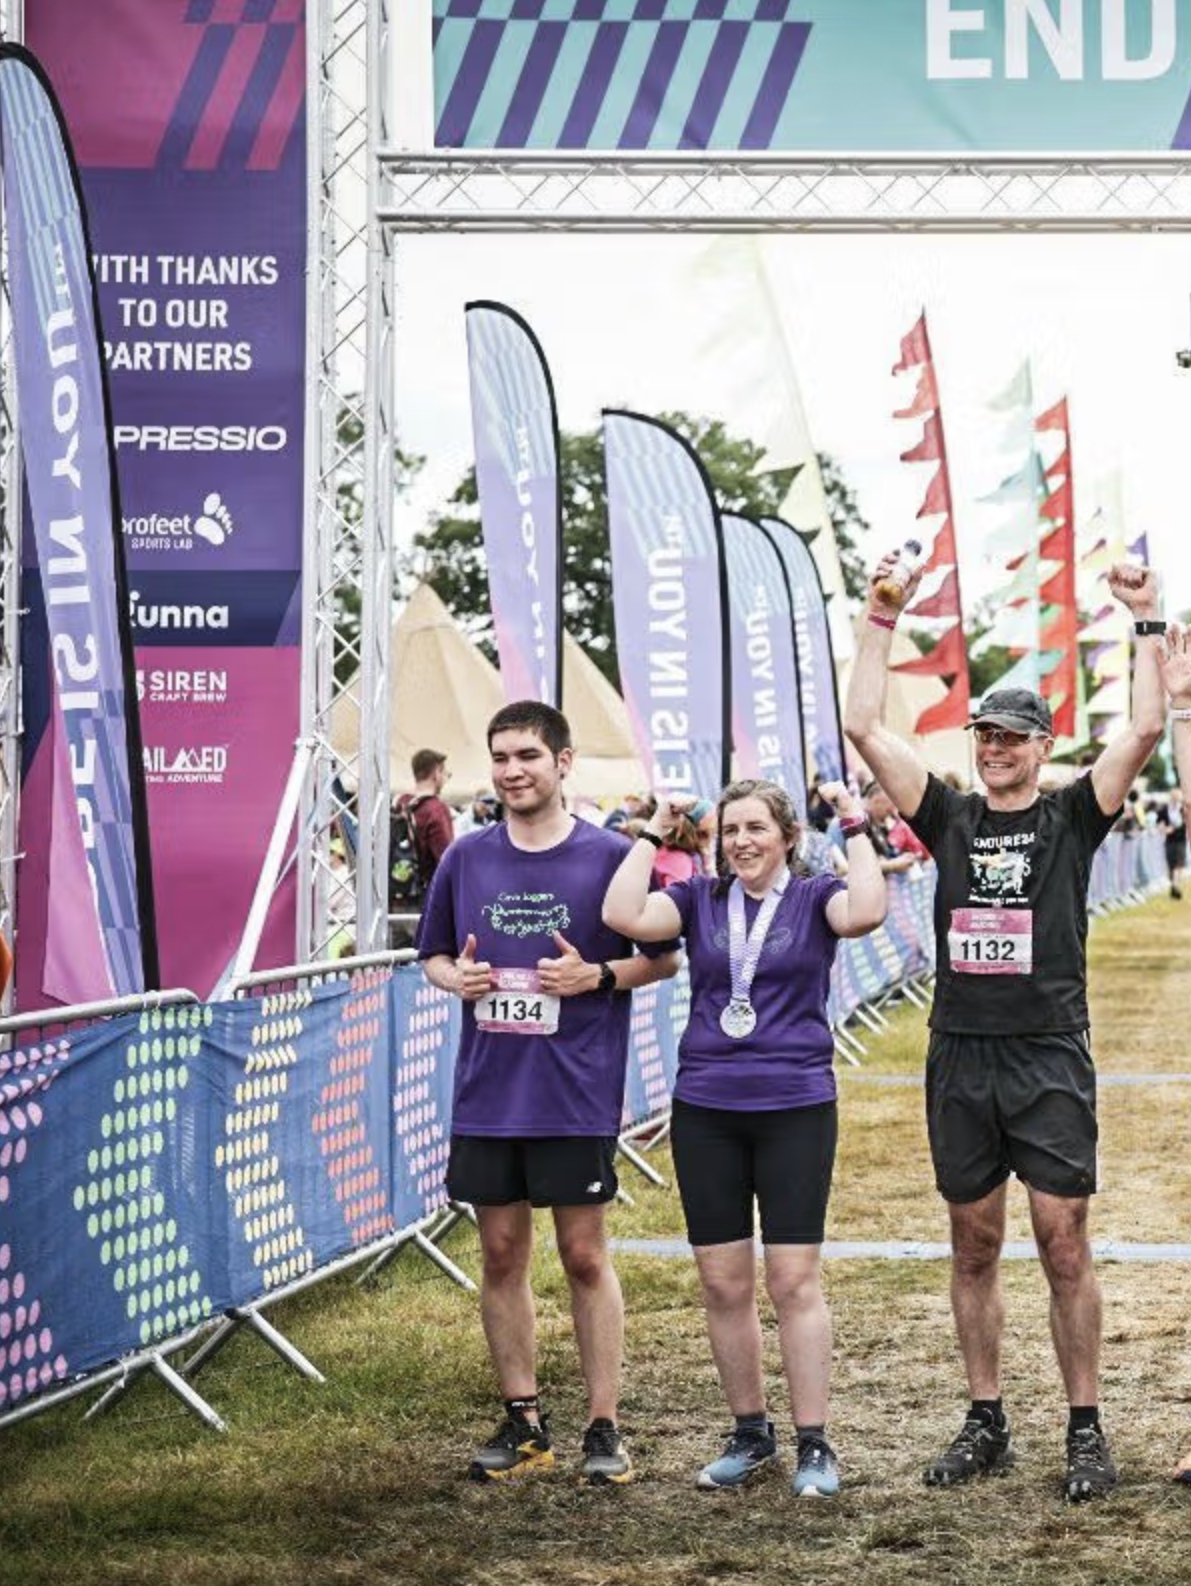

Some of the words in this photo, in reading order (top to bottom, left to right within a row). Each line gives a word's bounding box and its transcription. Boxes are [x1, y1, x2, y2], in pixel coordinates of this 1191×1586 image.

[92, 255, 149, 283] ITH
[157, 255, 279, 285] THANKS
[118, 298, 157, 327] TO
[165, 299, 229, 328] OUR
[113, 425, 287, 451] PRESSIO
[131, 538, 171, 549] SPORTS
[174, 538, 193, 549] LAB
[150, 671, 227, 691] SIREN
[150, 692, 188, 702] CRAFT
[193, 692, 227, 702] BREW
[167, 774, 223, 783] ADVENTURE
[961, 939, 1015, 961] 1132
[488, 998, 543, 1021] 1134
